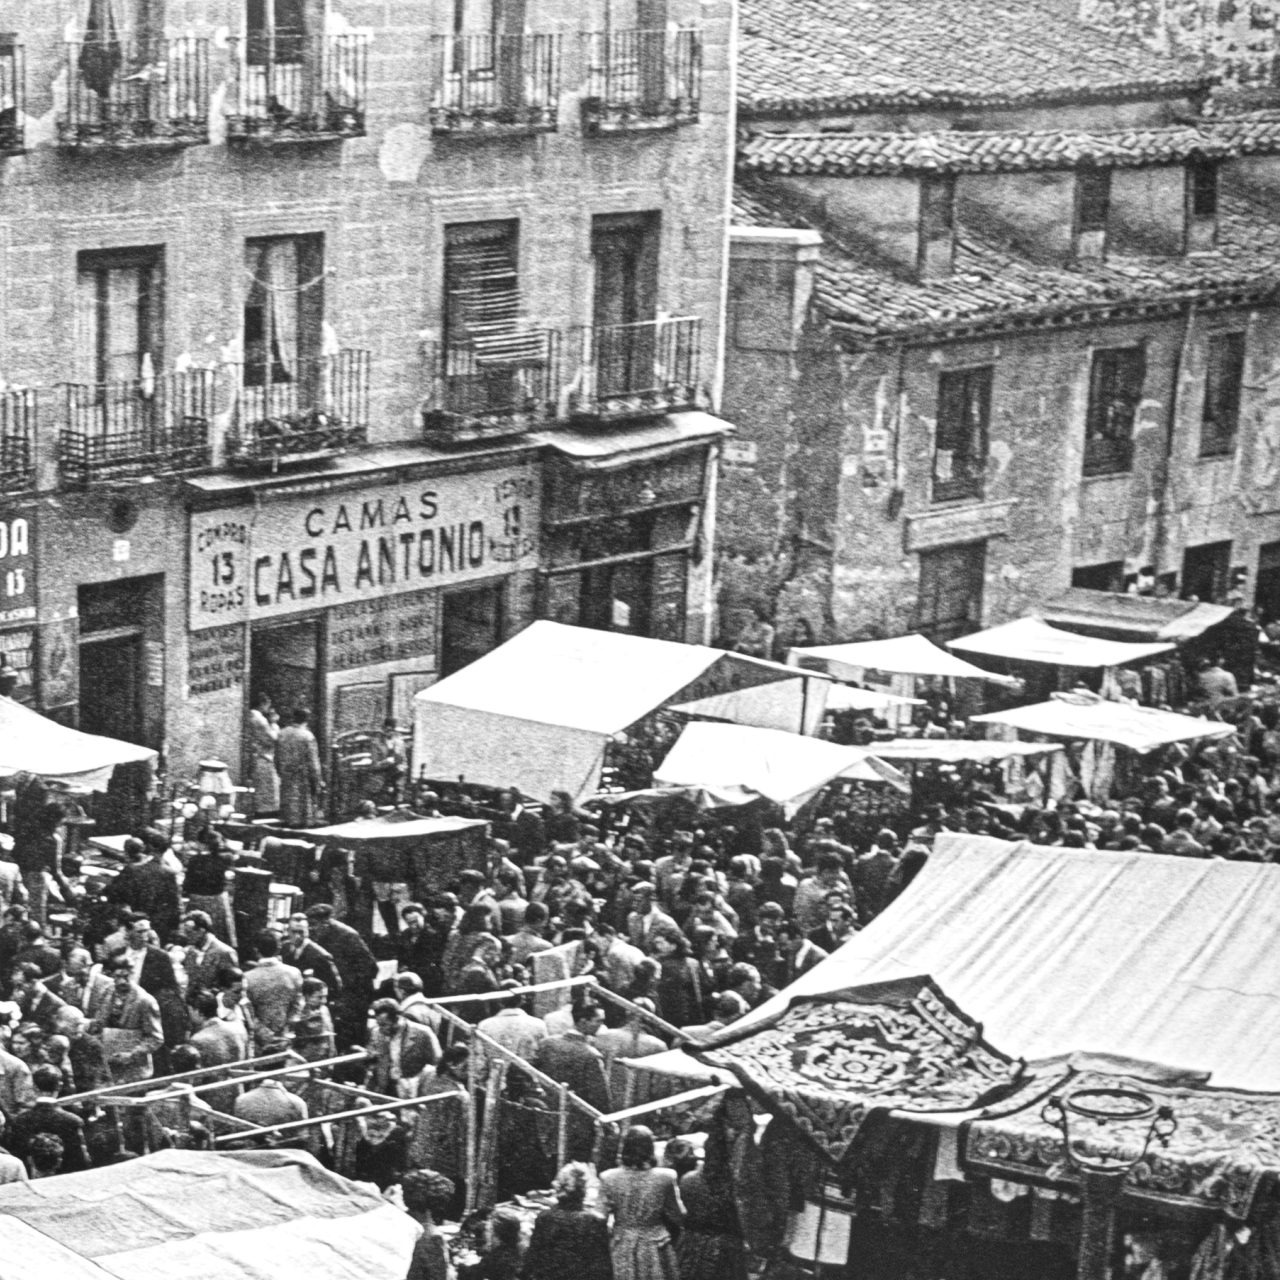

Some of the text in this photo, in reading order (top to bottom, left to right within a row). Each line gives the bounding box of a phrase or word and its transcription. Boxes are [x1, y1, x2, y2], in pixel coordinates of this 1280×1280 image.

[306, 491, 438, 538] CAMAS
[212, 551, 235, 586] 13
[254, 544, 340, 606] CASA
[355, 520, 485, 588] ANTONIO
